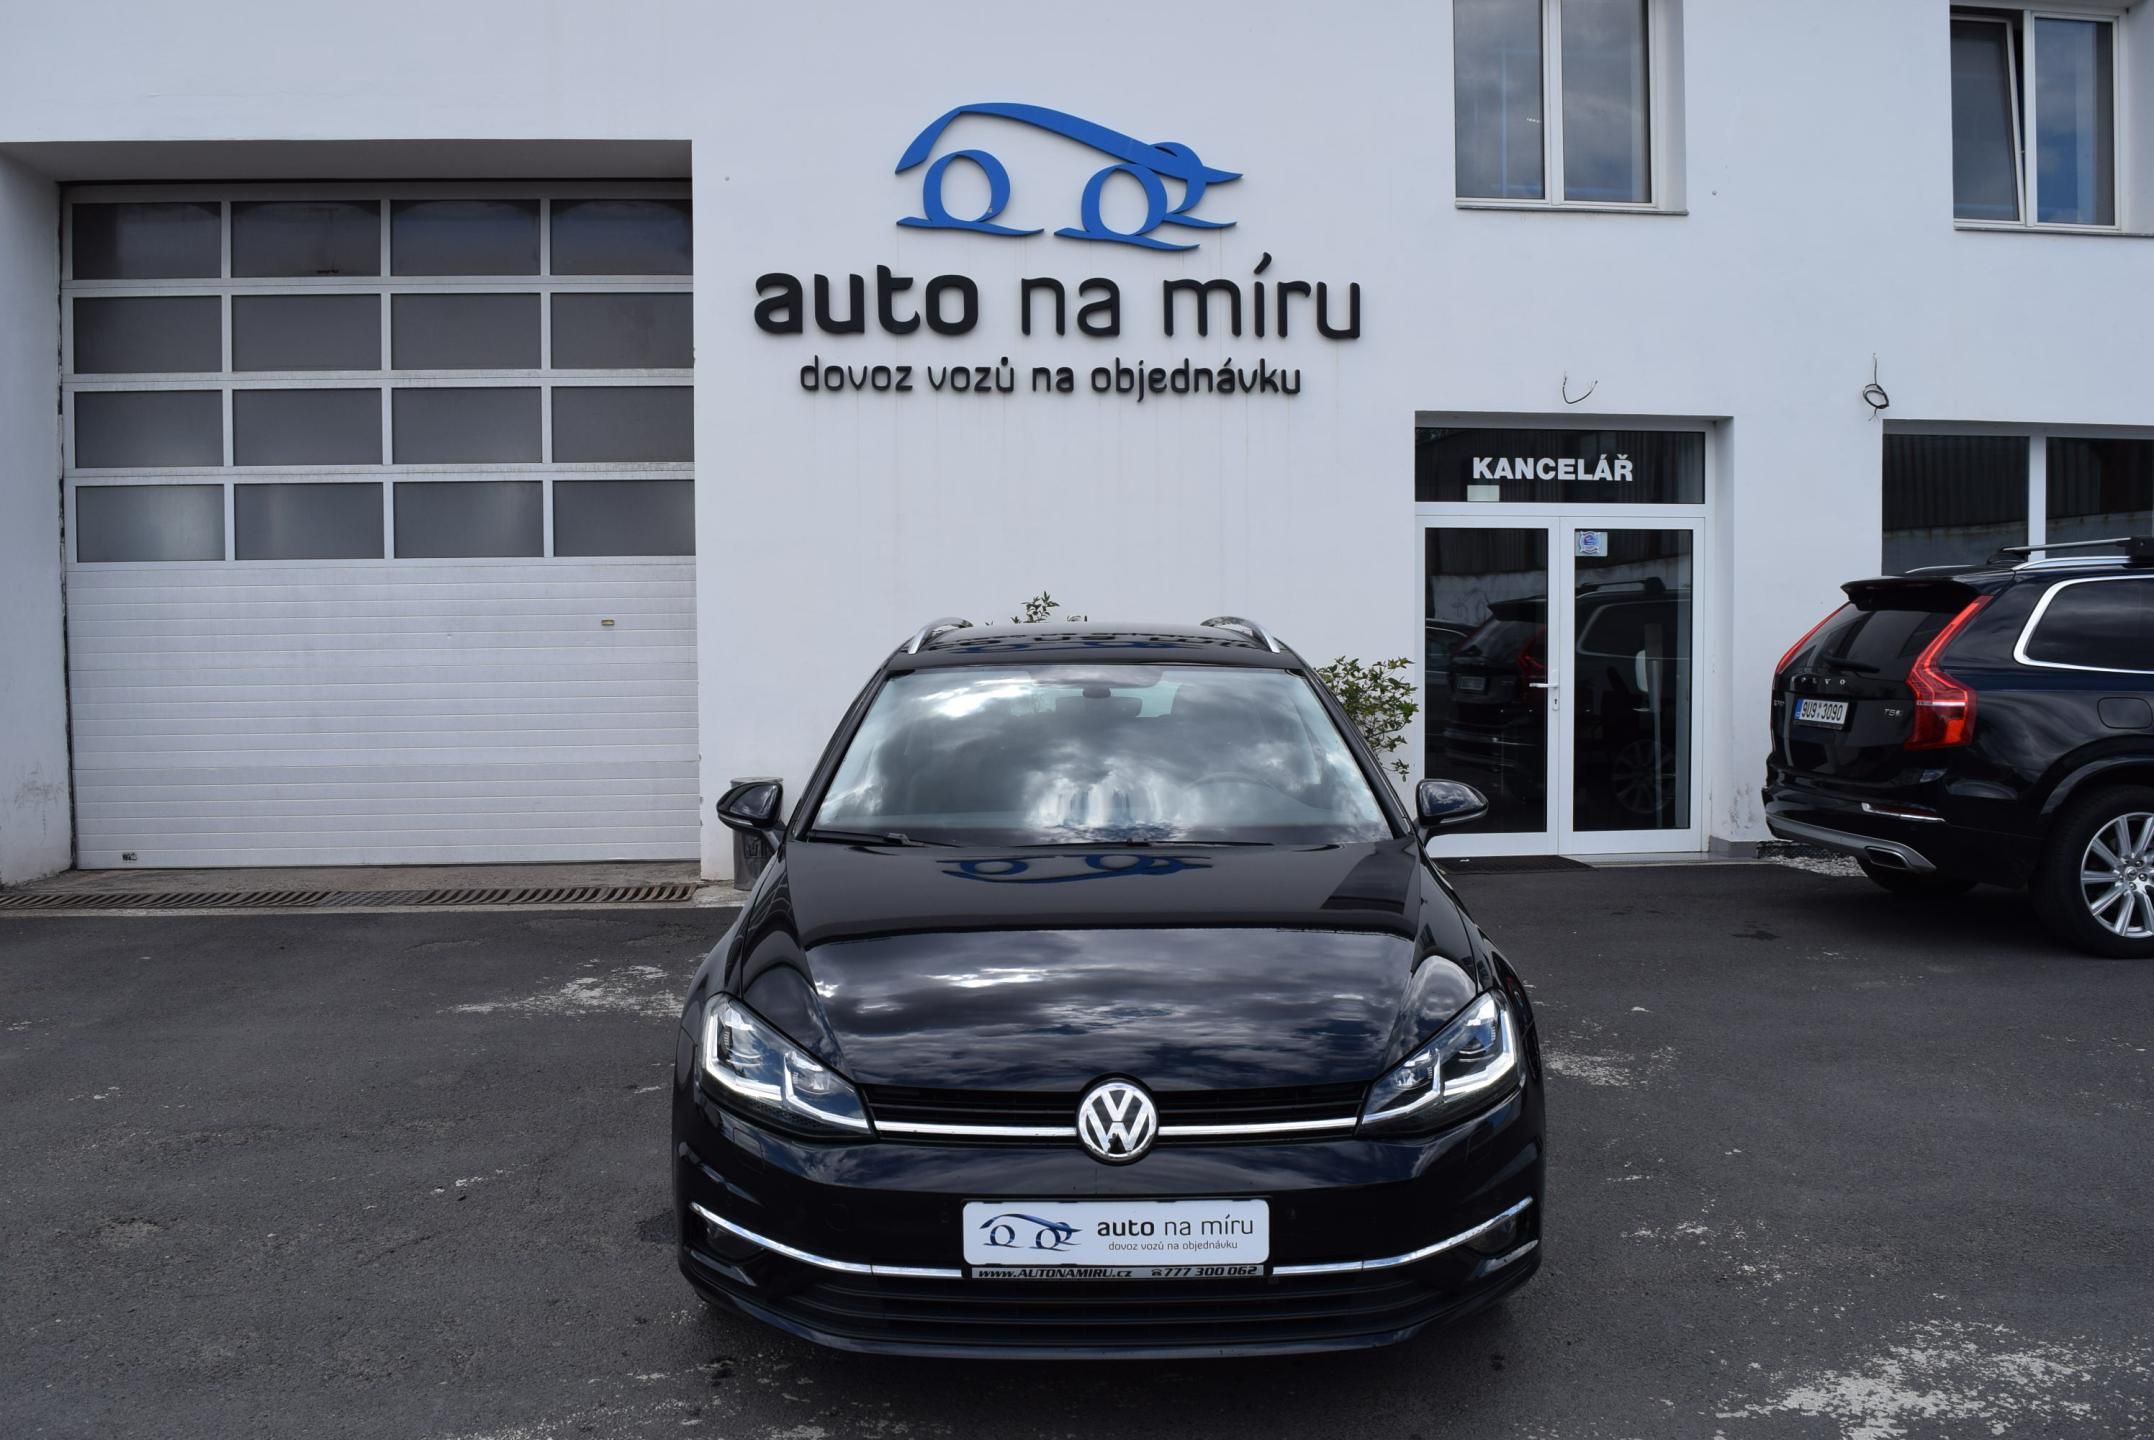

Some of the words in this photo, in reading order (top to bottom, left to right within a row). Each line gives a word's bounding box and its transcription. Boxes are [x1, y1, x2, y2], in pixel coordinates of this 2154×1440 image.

[753, 264, 979, 336] auto
[1020, 274, 1121, 338] na
[1163, 252, 1360, 339] míru
[799, 355, 914, 393] dovoz
[927, 356, 1016, 394] vozů
[1031, 363, 1075, 394] na
[1090, 358, 1302, 403] objednávku
[1472, 454, 1634, 482] KANCELÁŘ
[1097, 1219, 1155, 1237] auto
[1164, 1221, 1192, 1236] na
[1201, 1214, 1254, 1236] míru
[1108, 1241, 1138, 1251] dovoz
[1140, 1241, 1165, 1251] vozů
[1182, 1240, 1238, 1252] objednávku
[978, 1267, 1133, 1279] www.AUTONAMIRU.cz
[1163, 1268, 1192, 1278] 777
[1195, 1267, 1225, 1277] 300
[1227, 1266, 1258, 1276] 062
